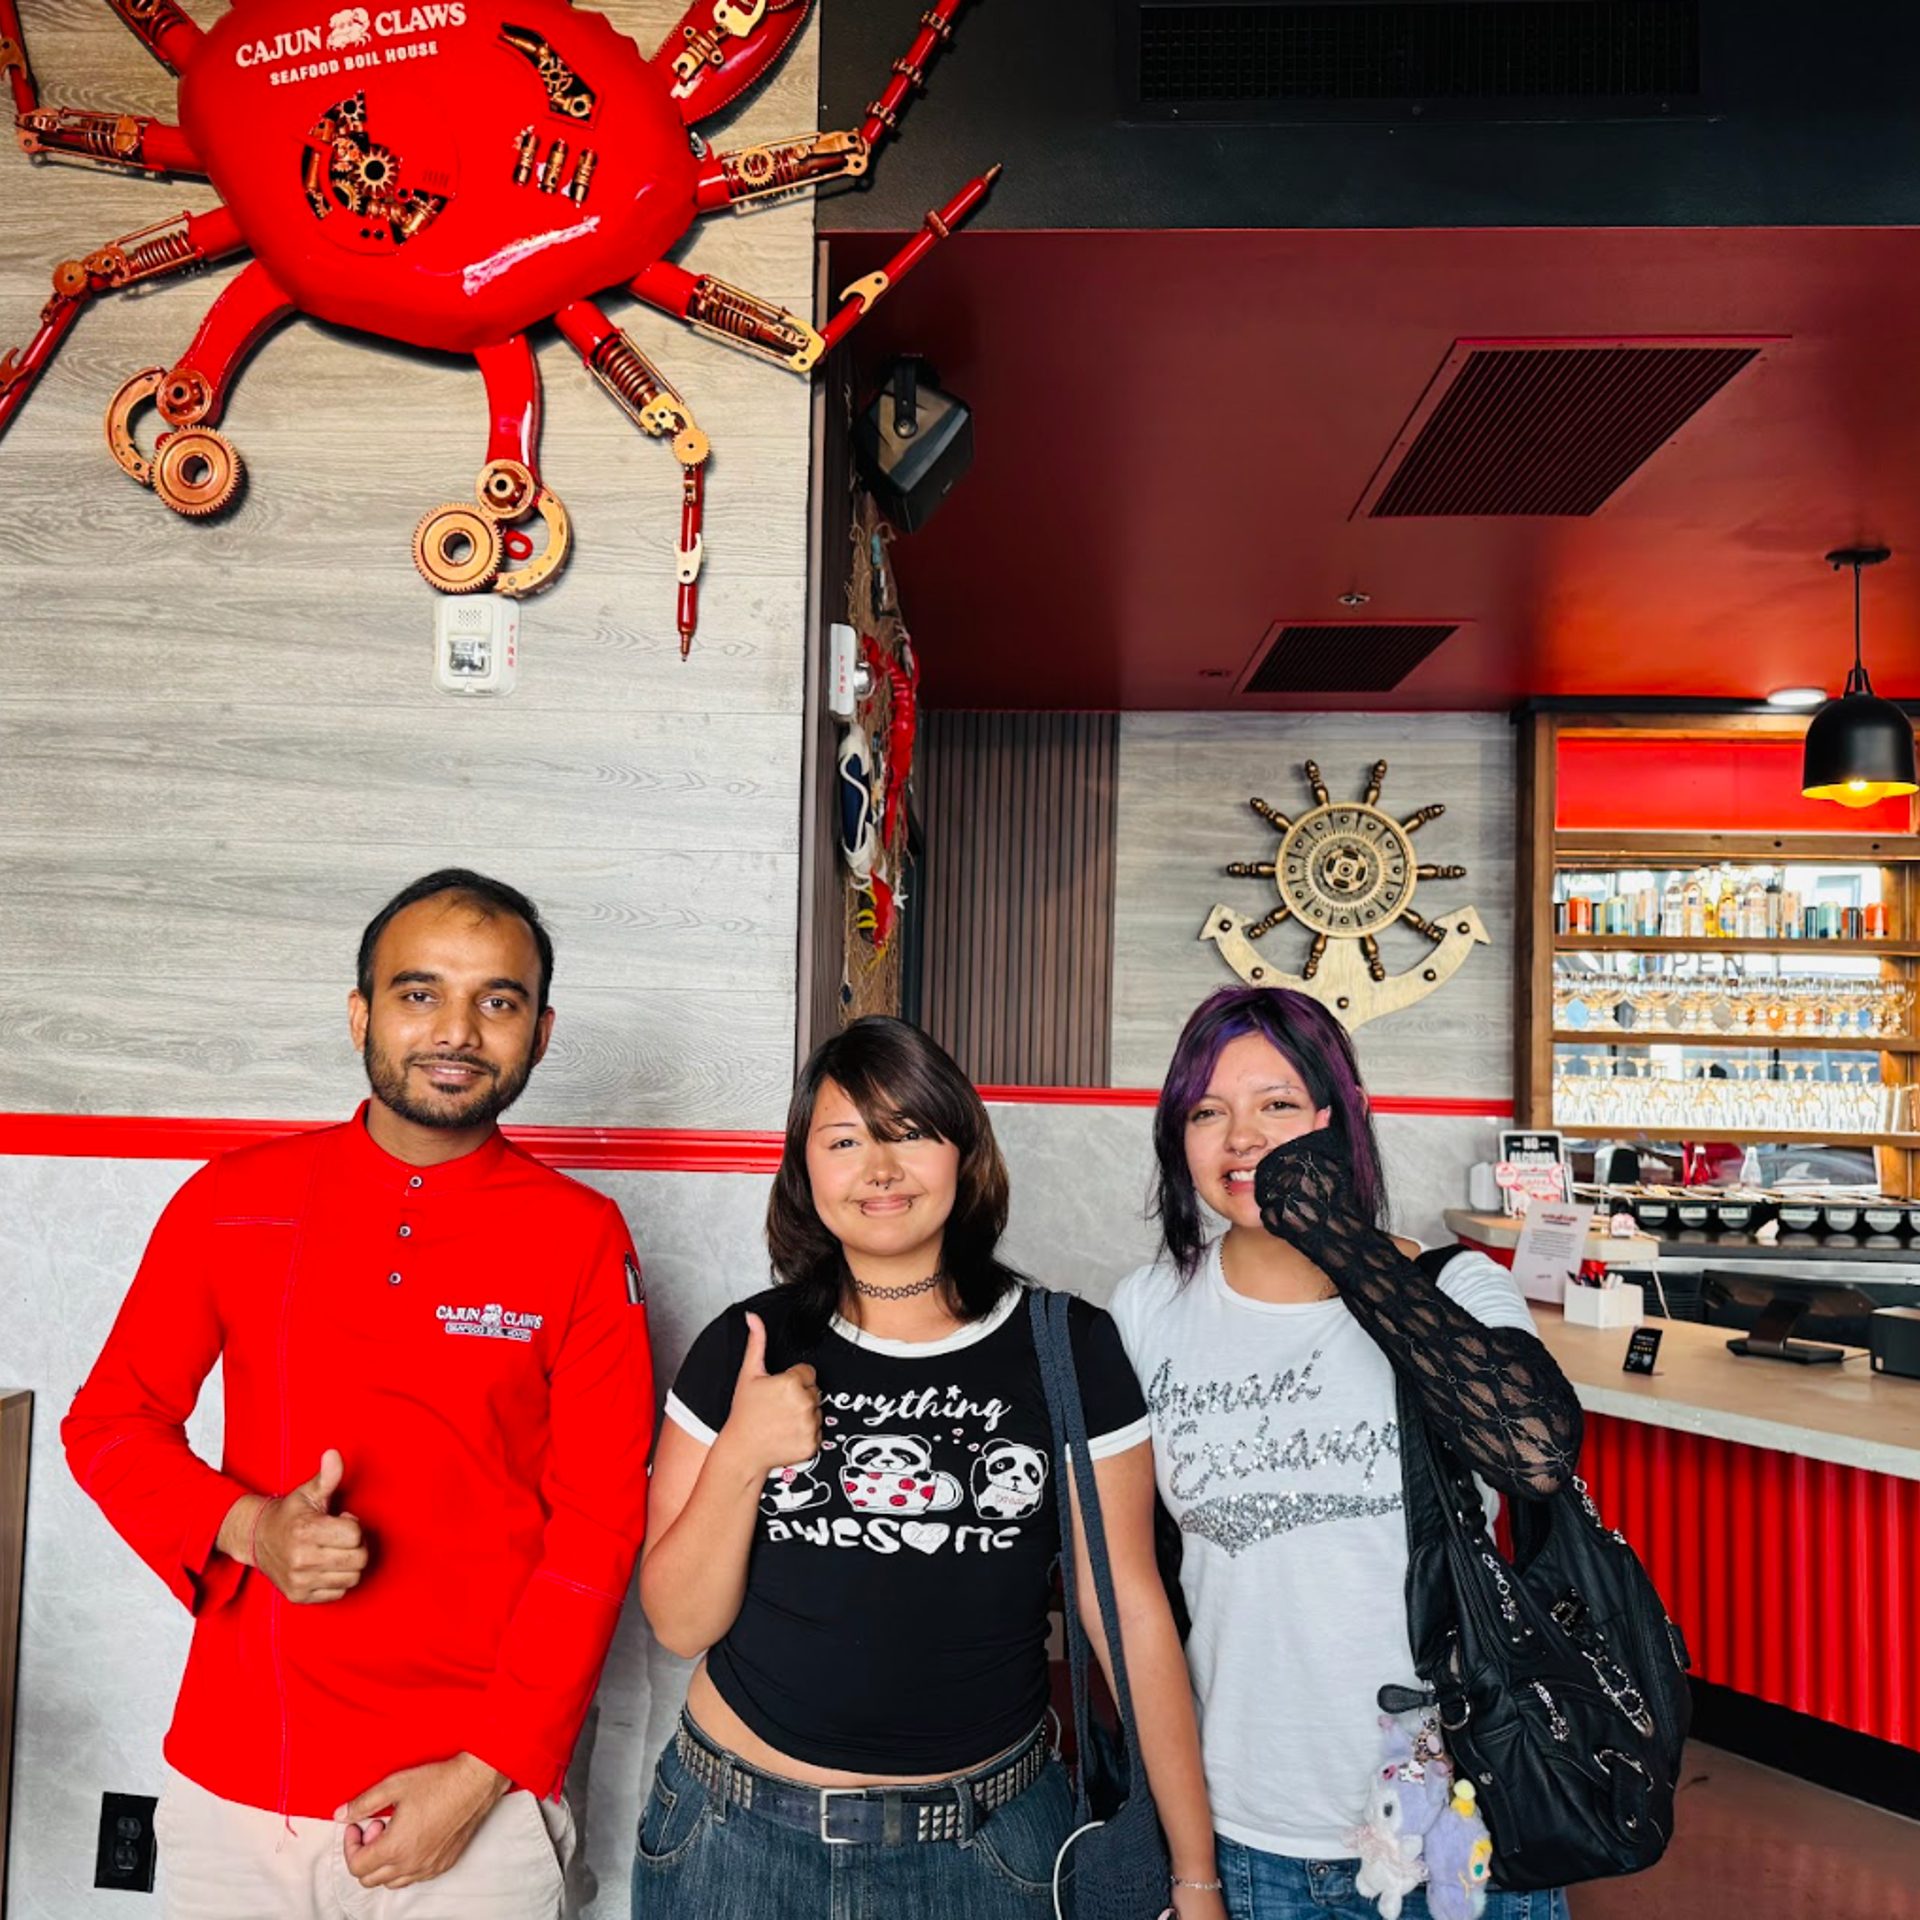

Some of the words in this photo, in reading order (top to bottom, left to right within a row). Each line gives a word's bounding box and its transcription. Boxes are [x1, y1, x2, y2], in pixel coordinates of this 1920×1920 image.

[235, 26, 322, 68] CAJUN
[374, 2, 467, 37] CLAWS
[269, 59, 339, 86] SEAFOOD
[344, 51, 381, 71] BOIL
[386, 41, 438, 63] HOUSE
[1523, 1136, 1540, 1150] NO
[436, 1305, 480, 1322] CAJUN
[503, 1311, 543, 1330] CLAWS
